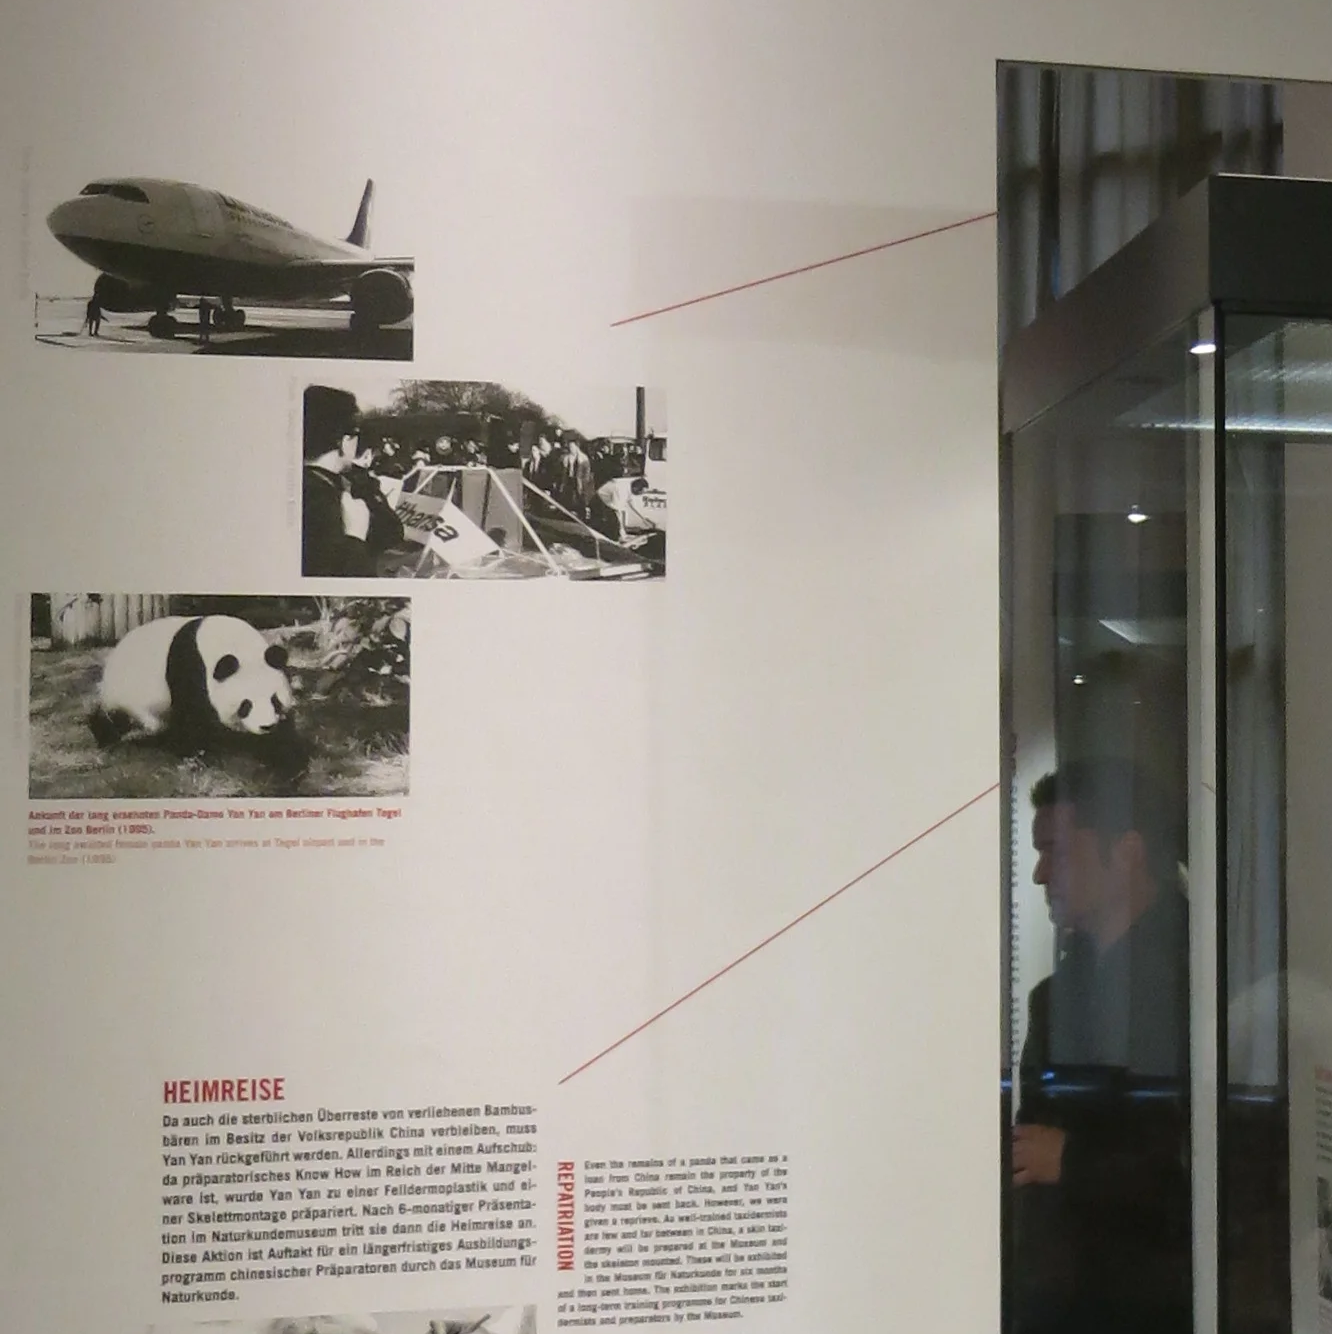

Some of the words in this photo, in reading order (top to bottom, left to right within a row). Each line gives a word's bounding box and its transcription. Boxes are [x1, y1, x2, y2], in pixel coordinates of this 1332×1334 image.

[164, 1078, 285, 1103] HEIMREISE
[163, 1115, 178, 1127] Da
[182, 1114, 214, 1126] auch
[218, 1113, 237, 1125] die
[241, 1112, 313, 1124] sterblichen
[317, 1108, 378, 1121] Überreste
[381, 1109, 404, 1119] von
[407, 1106, 480, 1118] verliehenen
[484, 1104, 536, 1116] Bambus-
[162, 1134, 198, 1146] bären
[205, 1133, 220, 1145] im
[226, 1132, 265, 1144] Besitz
[271, 1131, 291, 1142] der
[298, 1127, 383, 1141] Volksrepublik
[390, 1126, 424, 1138] China
[431, 1124, 499, 1136] verbleiben,
[506, 1124, 536, 1134] muss
[163, 1154, 185, 1166] Yan
[189, 1153, 212, 1165] Yan
[216, 1150, 289, 1165] rückgeführt
[292, 1149, 342, 1161] werden.
[346, 1146, 409, 1159] Allerdings
[413, 1144, 432, 1156] mit
[436, 1144, 473, 1155] einem
[476, 1142, 536, 1154] Aufschub:
[162, 1174, 177, 1185] da
[182, 1171, 290, 1186] präparatorisches
[295, 1168, 330, 1180] Know
[334, 1167, 361, 1178] How
[366, 1165, 381, 1177] im
[386, 1164, 421, 1176] Reich
[425, 1163, 445, 1175] der
[450, 1162, 481, 1173] Mitte
[486, 1160, 536, 1174] Mangel-
[162, 1195, 193, 1205] ware
[199, 1191, 218, 1204] ist,
[225, 1190, 263, 1202] wurde
[269, 1189, 292, 1200] Yan
[298, 1188, 320, 1199] Yan
[326, 1188, 340, 1199] zu
[347, 1185, 378, 1197] einer
[384, 1181, 487, 1195] Felldermoplastik
[493, 1180, 514, 1191] und
[520, 1178, 536, 1190] ei-
[162, 1214, 183, 1224] ner
[187, 1210, 286, 1223] Skelettmontage
[291, 1206, 357, 1221] präpariert.
[362, 1204, 393, 1216] Nach
[398, 1201, 474, 1214] 6-monatiger
[478, 1199, 536, 1210] Präsenta-
[557, 1162, 574, 1271] REPATRIATION
[161, 1232, 186, 1244] tion
[191, 1230, 206, 1243] im
[211, 1228, 337, 1242] Naturkundemuseum
[342, 1224, 364, 1236] tritt
[369, 1223, 387, 1235] sie
[392, 1223, 422, 1234] dann
[427, 1220, 446, 1232] die
[451, 1219, 513, 1231] Heimreise
[518, 1219, 535, 1228] an.
[162, 1251, 197, 1263] Diese
[202, 1250, 242, 1262] Aktion
[248, 1248, 263, 1260] ist
[267, 1246, 312, 1259] Auftakt
[316, 1244, 333, 1257] für
[338, 1243, 357, 1255] ein
[363, 1241, 452, 1255] längerfristiges
[456, 1237, 536, 1250] Ausbildungs-
[161, 1272, 225, 1285] programm
[230, 1266, 312, 1280] chinesischer
[315, 1263, 396, 1276] Präparatoren
[401, 1259, 436, 1272] durch
[440, 1259, 461, 1270] das
[465, 1257, 516, 1268] Museum
[520, 1254, 536, 1266] für
[161, 1289, 238, 1303] Naturkunde.
